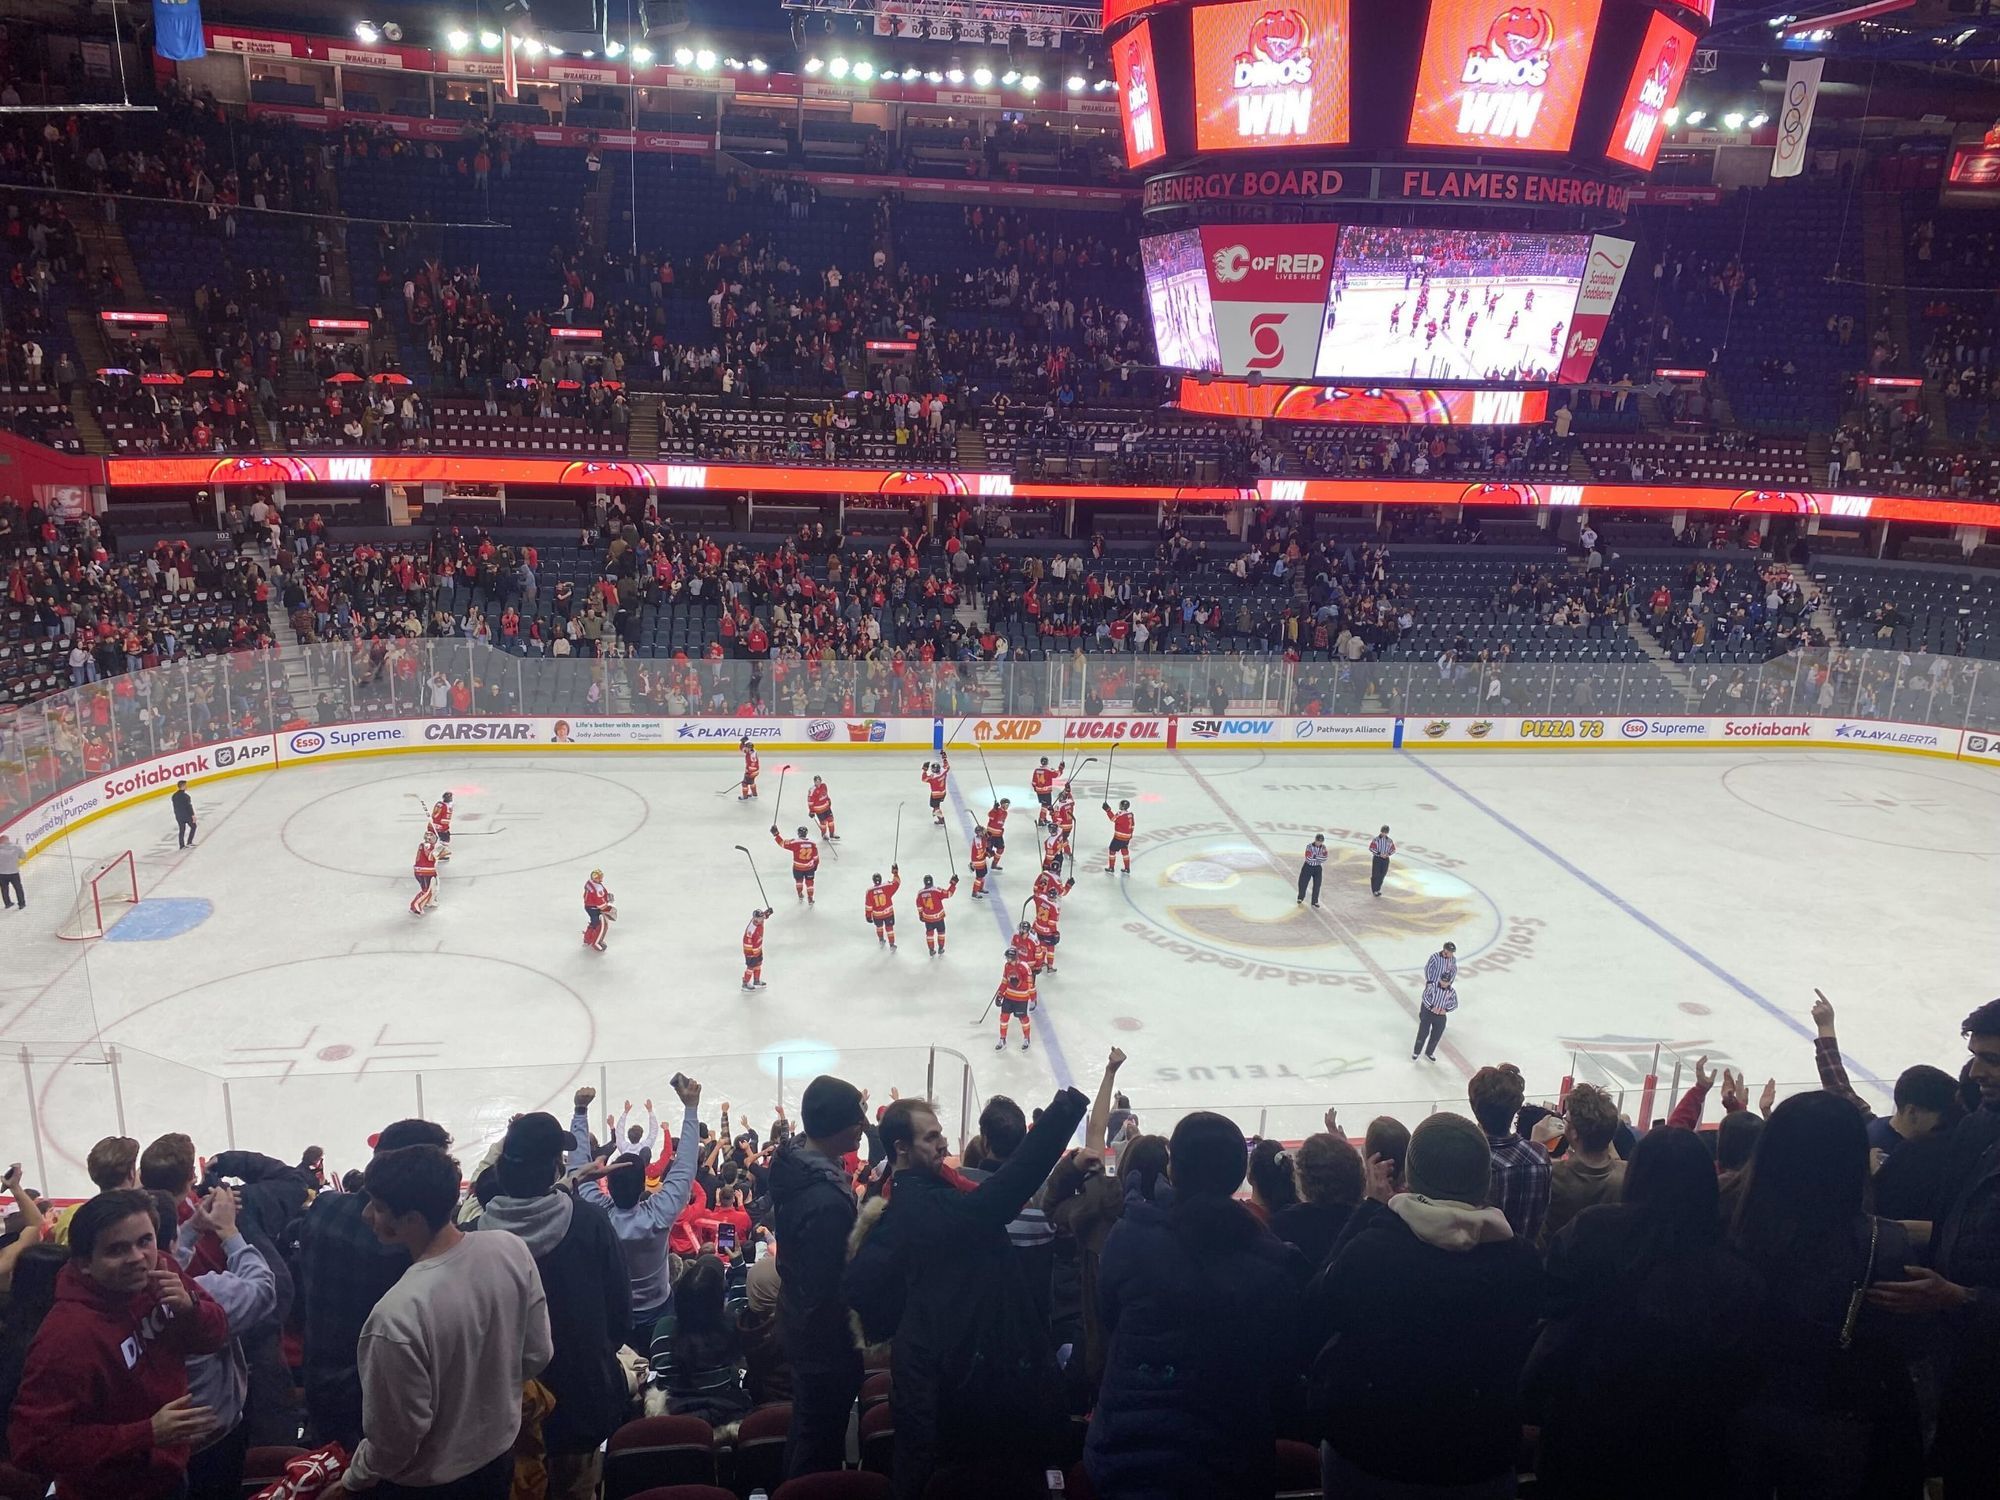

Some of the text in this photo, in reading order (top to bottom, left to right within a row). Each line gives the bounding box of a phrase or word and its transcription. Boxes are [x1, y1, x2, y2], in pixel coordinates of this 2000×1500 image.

[345, 54, 387, 65] WRANGLERS
[563, 72, 602, 81] WRANGLERS
[1233, 57, 1313, 89] DINOS
[1460, 54, 1551, 88] DINOS
[1238, 87, 1313, 136] WIN
[1456, 90, 1544, 138] WIN
[1132, 111, 1154, 154] WIN
[1623, 109, 1658, 156] WIN
[1165, 173, 1238, 203] ENERGY
[1243, 170, 1343, 196] BOARD
[1403, 171, 1519, 200] FLAMES
[1525, 175, 1606, 206] ENERGY
[1251, 256, 1275, 271] OF
[1276, 254, 1324, 273] RED
[1472, 388, 1524, 425] WIN
[328, 457, 371, 480] WIN
[667, 466, 706, 487] WIN
[978, 474, 1014, 496] WIN
[1270, 480, 1307, 501] WIN
[1549, 485, 1585, 506] WIN
[1830, 495, 1873, 517] WIN
[216, 532, 230, 540] 102
[424, 723, 531, 741] CARSTAR
[698, 727, 782, 738] PLAYALBERTA
[993, 720, 1043, 740] SKIP
[1064, 721, 1160, 739] LUCAS OIL
[1222, 720, 1275, 734] NOW
[1316, 725, 1387, 735] Pathways Alliance
[1520, 720, 1605, 738] PIZZA 73
[1626, 722, 1645, 734] Esso
[1650, 722, 1705, 736] Supreme
[1723, 721, 1811, 737] Scotiabank
[295, 737, 321, 749] Esso
[330, 729, 402, 746] Supreme
[1852, 729, 1938, 746] PLAYALBERTA
[104, 754, 210, 801] Scotiabank
[51, 795, 74, 811] TELUS
[25, 798, 98, 845] Powered by Purpose
[1121, 921, 1377, 994] Saddledome
[1397, 916, 1546, 988] Scotiabak
[1155, 1064, 1299, 1083] TELUS
